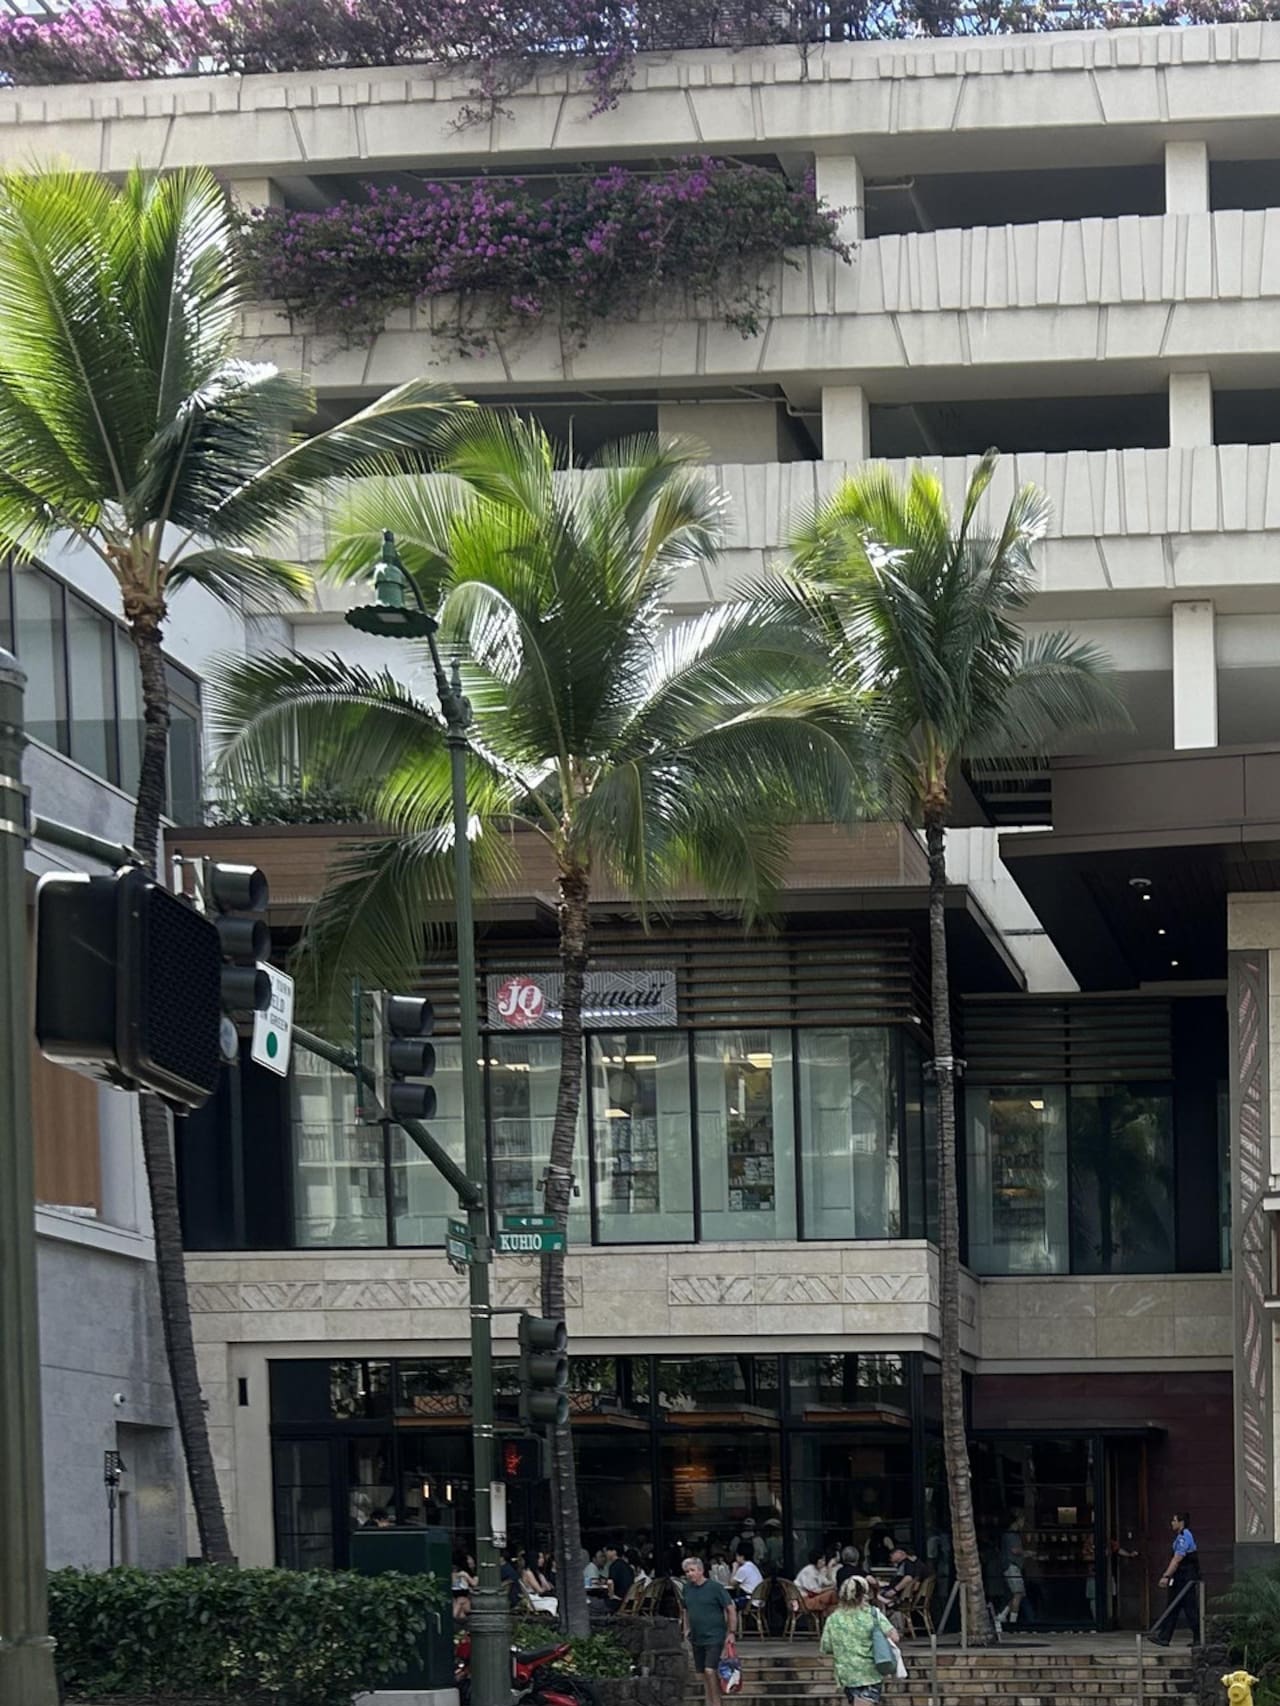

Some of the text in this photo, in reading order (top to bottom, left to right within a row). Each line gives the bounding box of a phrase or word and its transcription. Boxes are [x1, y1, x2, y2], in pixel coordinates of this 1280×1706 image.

[498, 983, 665, 1017] JQ awaii
[500, 1233, 543, 1251] KUHIO
